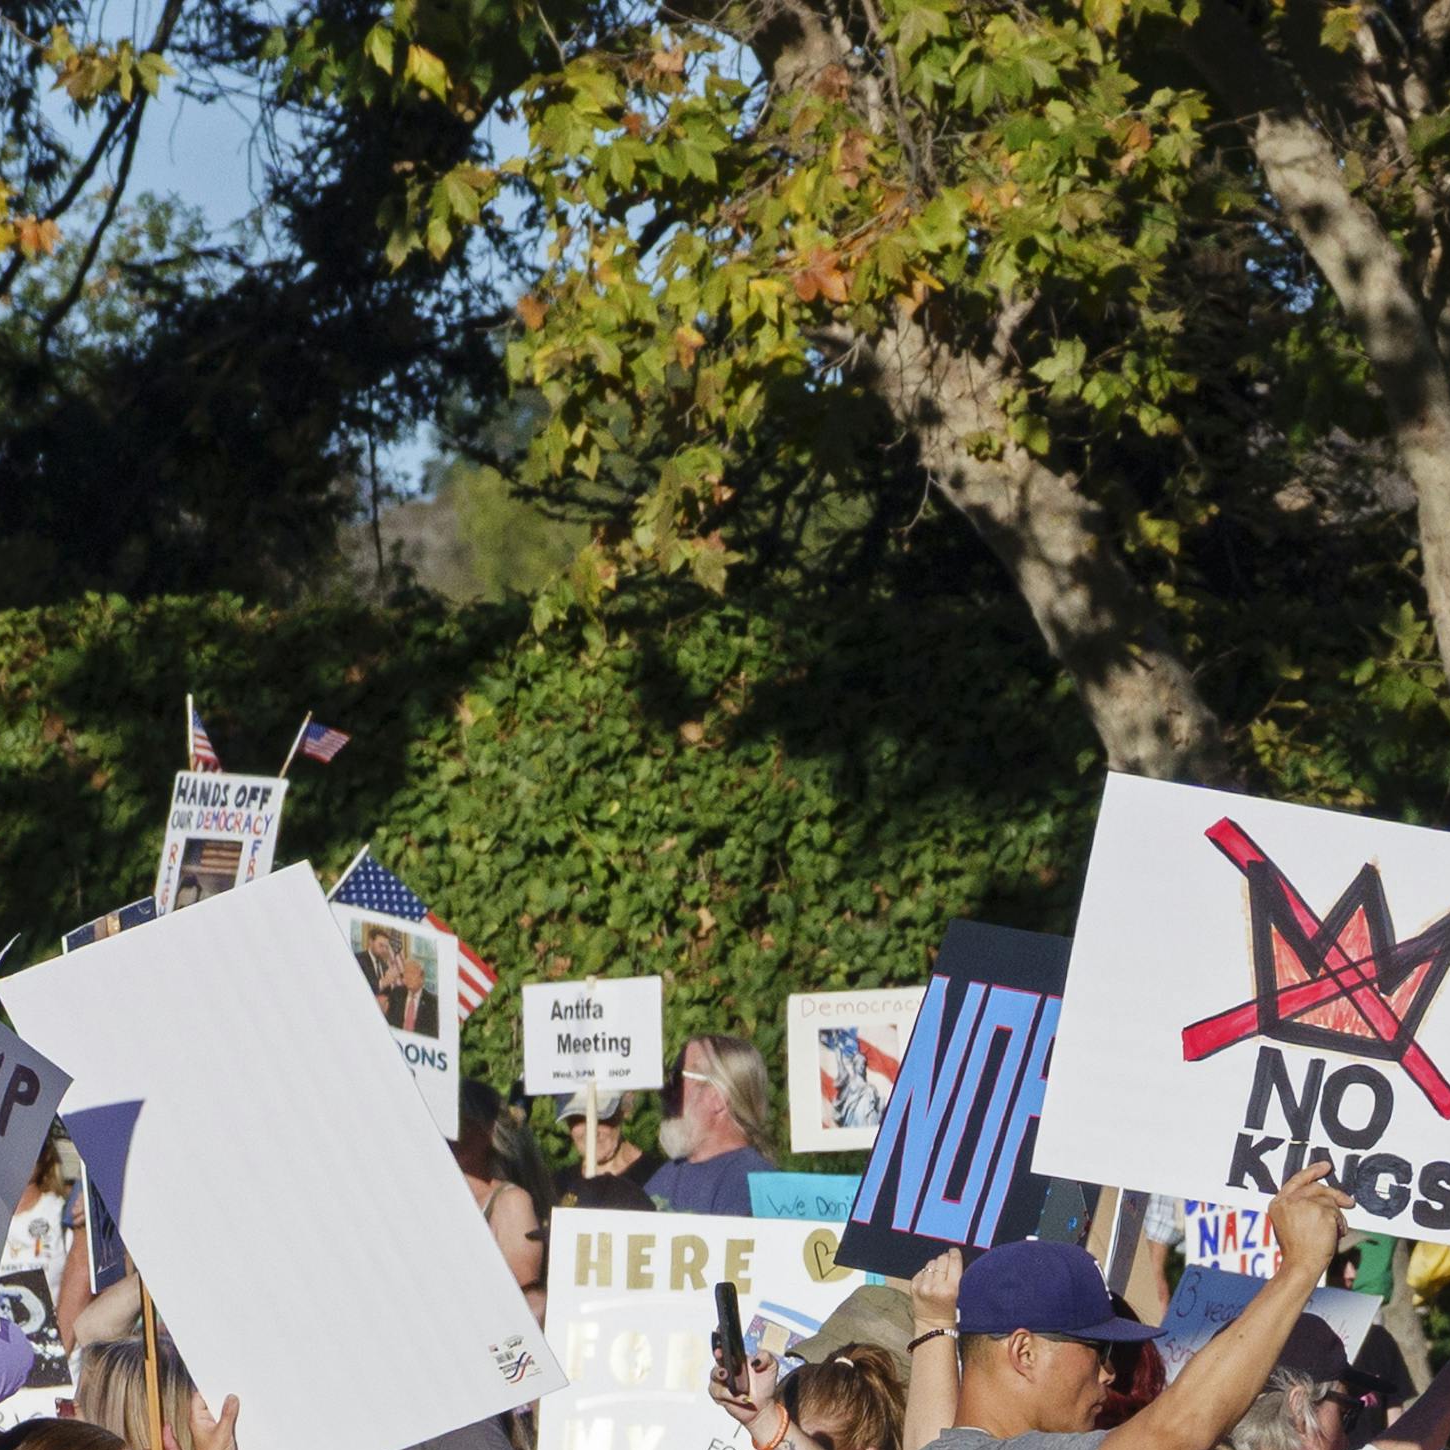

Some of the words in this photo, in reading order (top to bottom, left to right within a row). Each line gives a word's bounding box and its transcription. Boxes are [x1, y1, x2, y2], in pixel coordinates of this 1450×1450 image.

[175, 776, 230, 807] HANDS
[234, 785, 273, 810] OFF
[171, 810, 193, 830] OUR
[196, 809, 274, 836] DEMOCRACY
[550, 998, 603, 1021] Antifa
[801, 997, 921, 1018] Democrac
[557, 1032, 631, 1057] Meeting
[1244, 1045, 1395, 1151] NO
[767, 1195, 806, 1217] We
[815, 1195, 855, 1217] Don'
[574, 1231, 755, 1295] HERE
[565, 1321, 707, 1392] FOR
